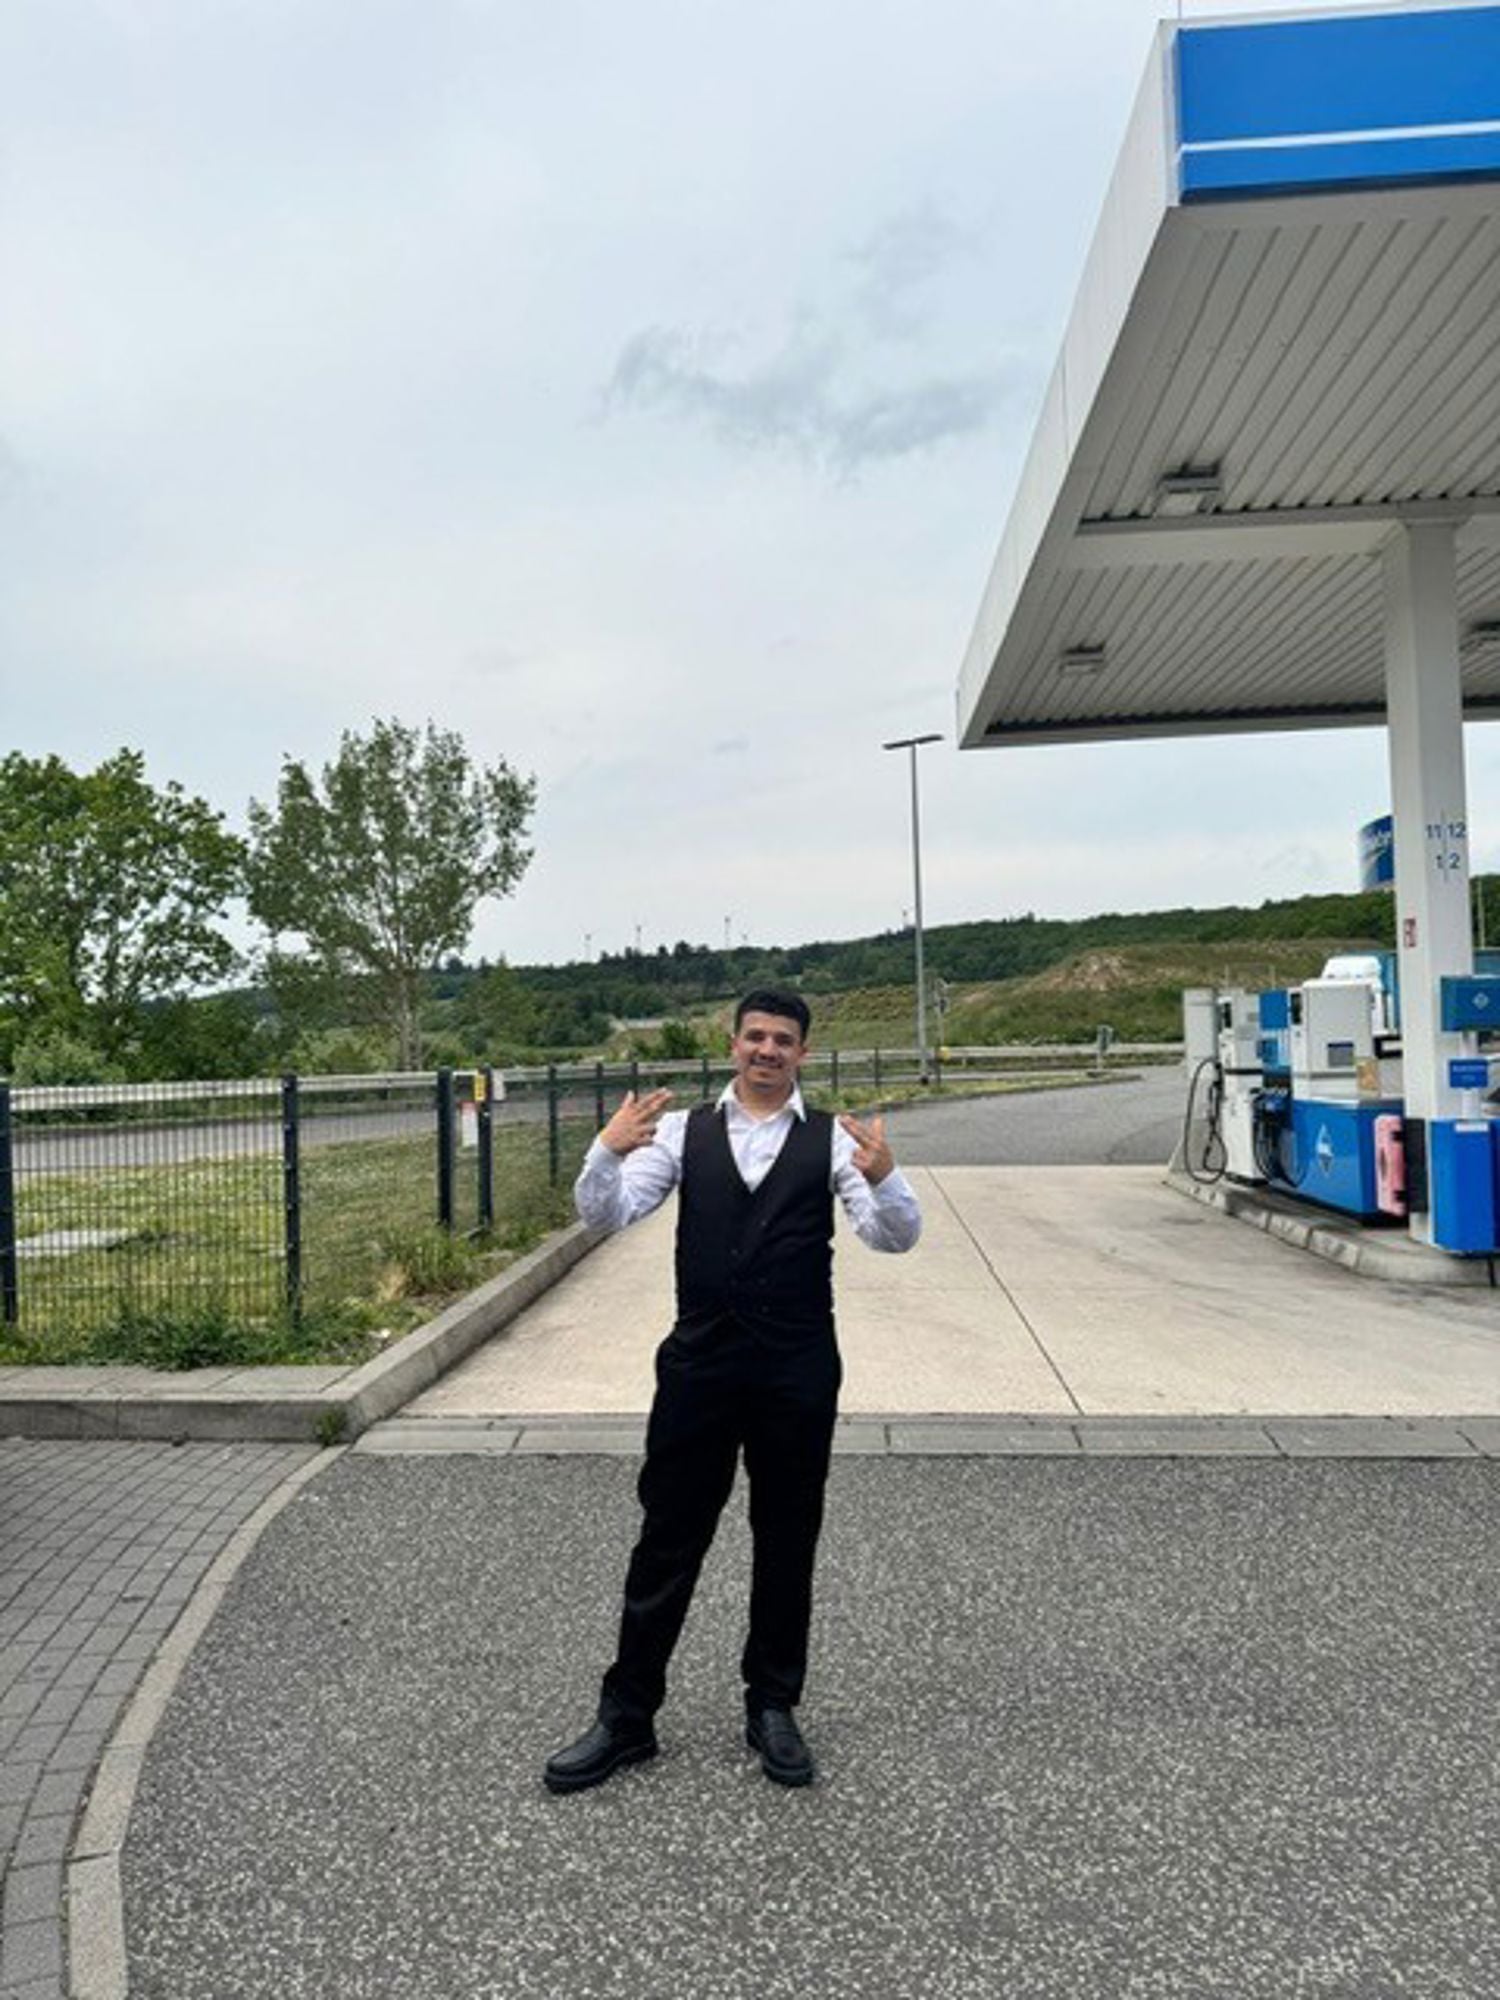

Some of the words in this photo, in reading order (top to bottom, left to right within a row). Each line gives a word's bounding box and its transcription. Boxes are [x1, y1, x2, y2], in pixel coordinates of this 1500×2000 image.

[1426, 824, 1442, 839] 11
[1448, 822, 1466, 838] 12
[1449, 852, 1461, 869] 2
